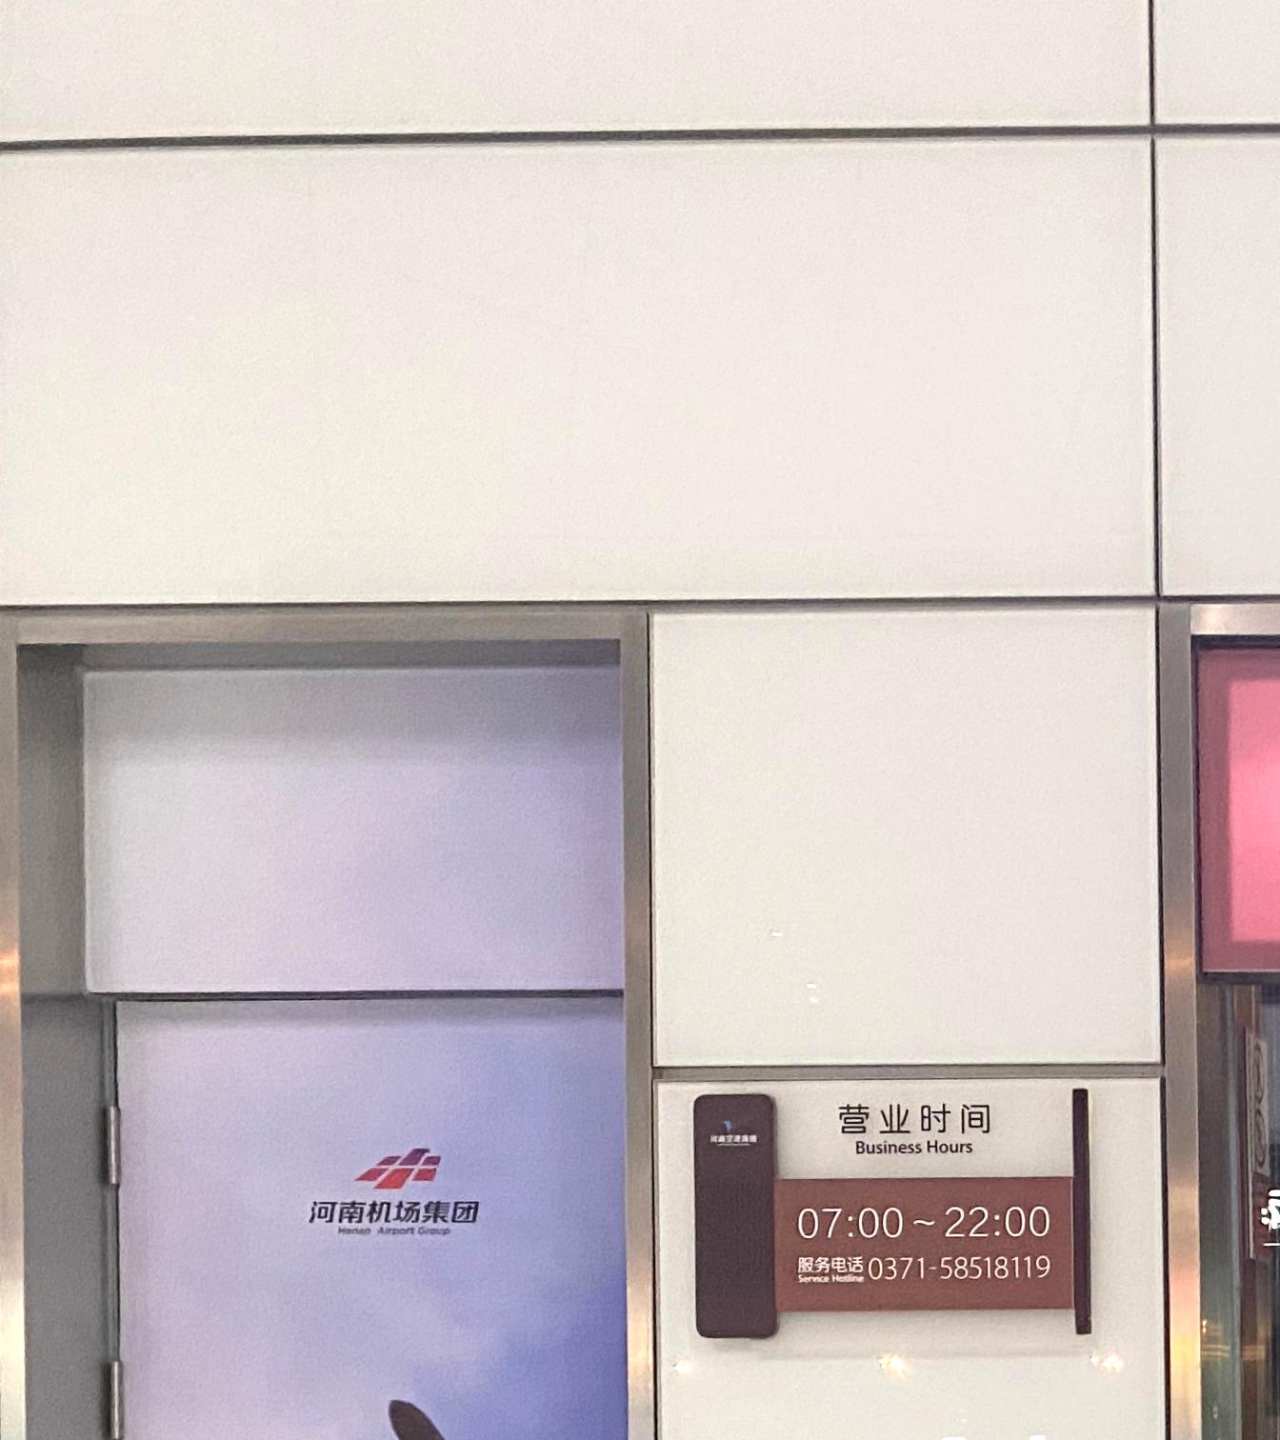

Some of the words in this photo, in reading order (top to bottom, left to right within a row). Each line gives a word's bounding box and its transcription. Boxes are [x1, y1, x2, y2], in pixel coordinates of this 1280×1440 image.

[838, 1103, 991, 1135] 营业时间
[855, 1140, 922, 1155] Business
[926, 1140, 973, 1154] Hours
[308, 1200, 480, 1224] 河南机场集团
[337, 1226, 372, 1236] Henan
[377, 1226, 415, 1236] Airport
[417, 1226, 451, 1236] Group
[797, 1256, 864, 1273] 服务电话
[868, 1255, 1051, 1281] 0371-58518119
